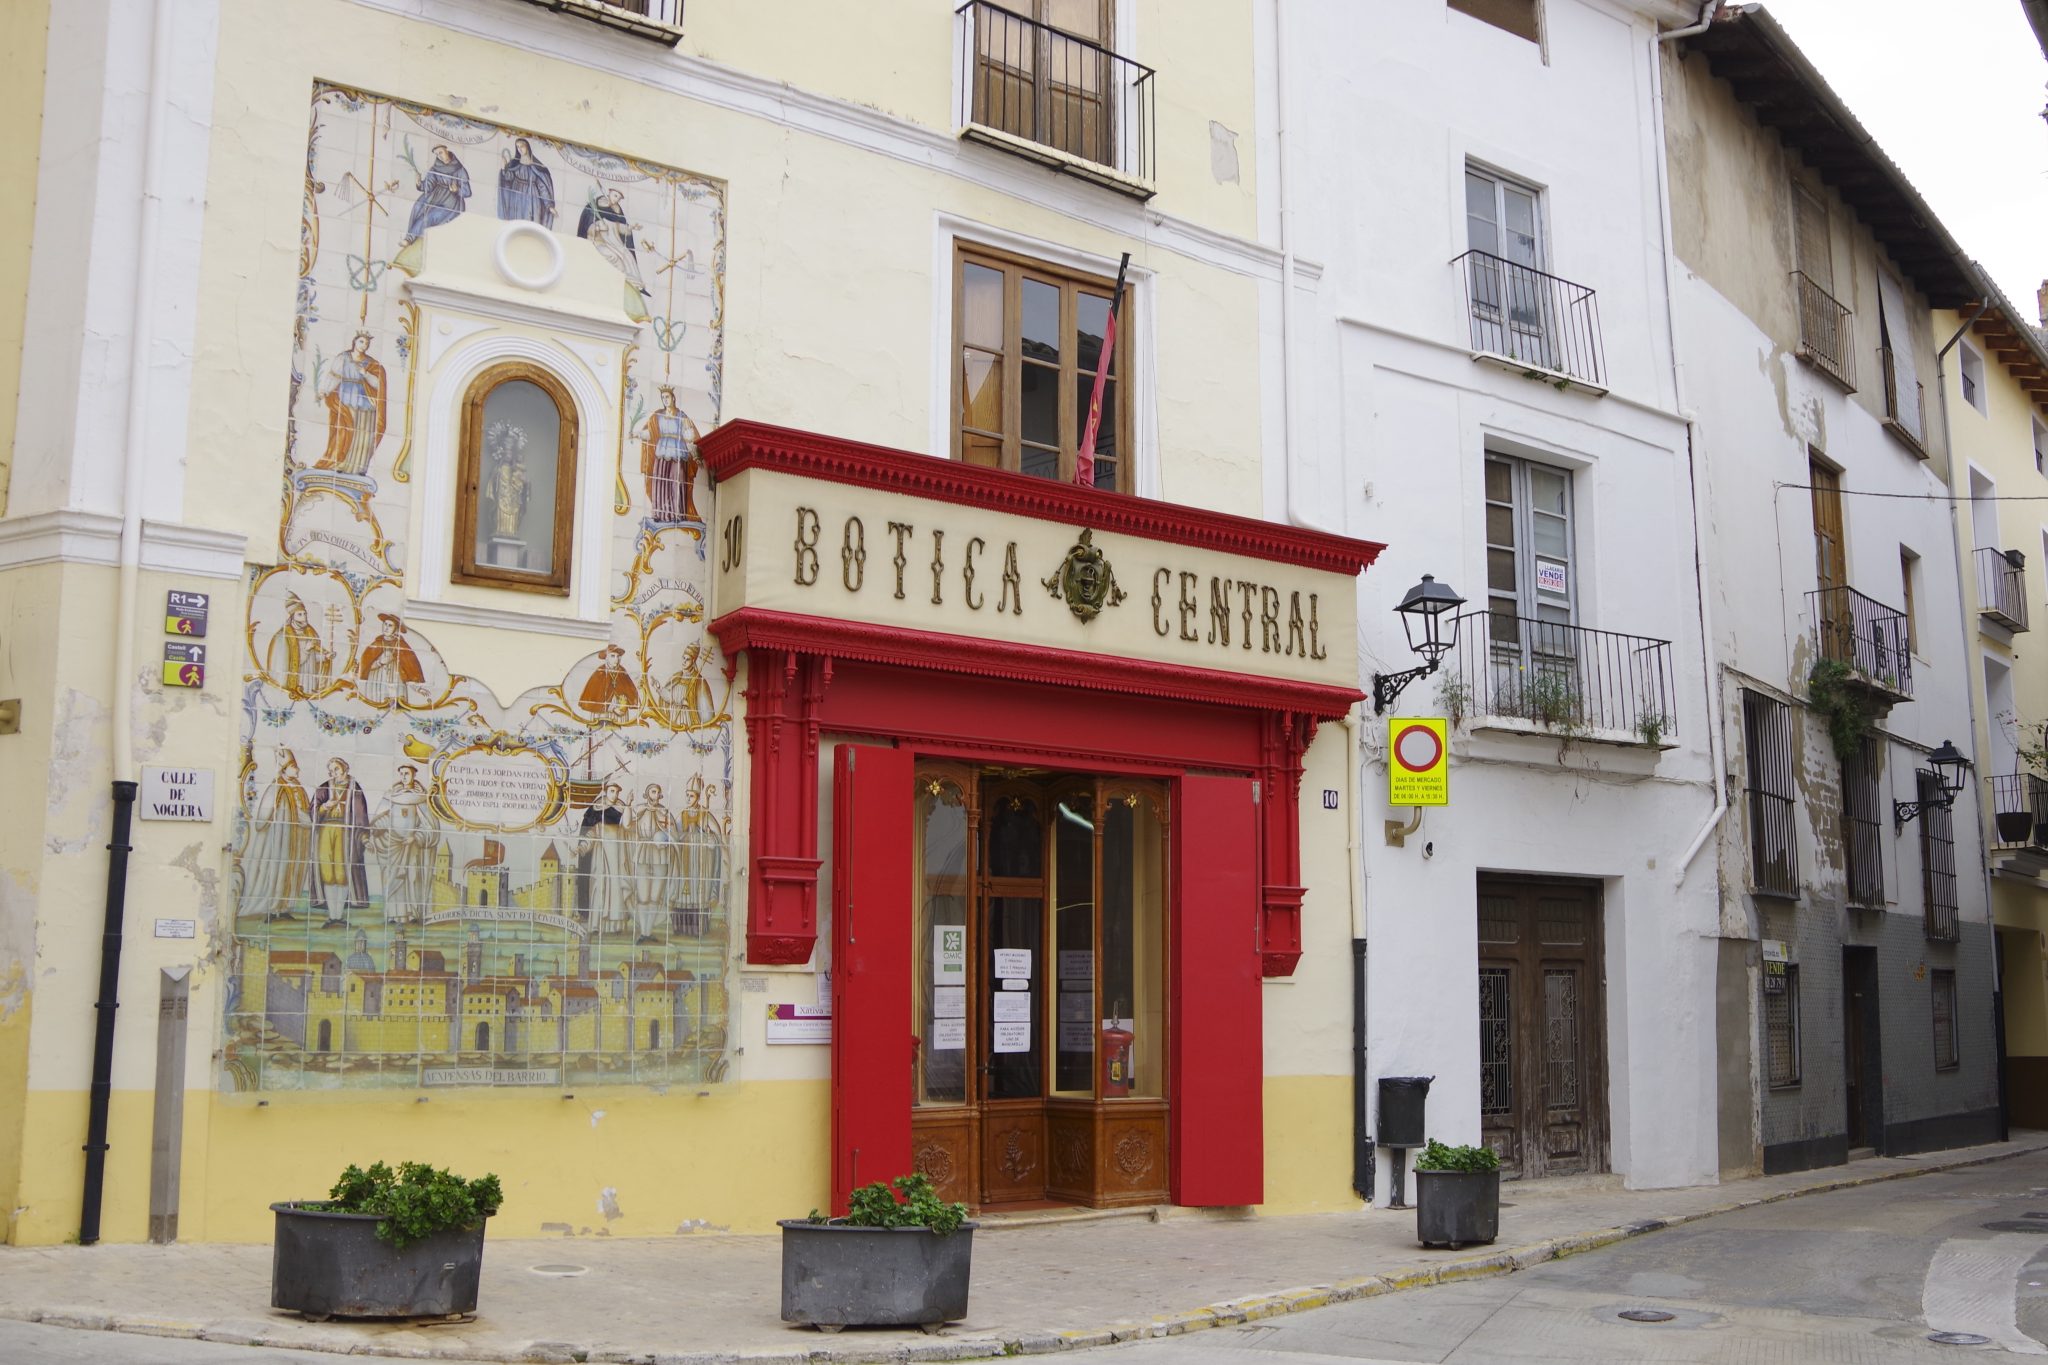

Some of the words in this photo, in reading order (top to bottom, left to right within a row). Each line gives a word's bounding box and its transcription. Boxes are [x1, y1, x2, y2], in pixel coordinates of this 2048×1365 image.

[722, 515, 743, 573] 10
[1538, 568, 1564, 581] VENDE
[793, 506, 1023, 616] BOTICA
[1152, 567, 1327, 660] CENTRAL
[171, 592, 186, 604] R1
[161, 771, 197, 785] CALLE
[169, 788, 186, 801] DE
[1325, 791, 1337, 808] 10
[152, 803, 204, 817] NOGUERA
[943, 952, 962, 960] OMIC
[1766, 961, 1786, 975] VENDE
